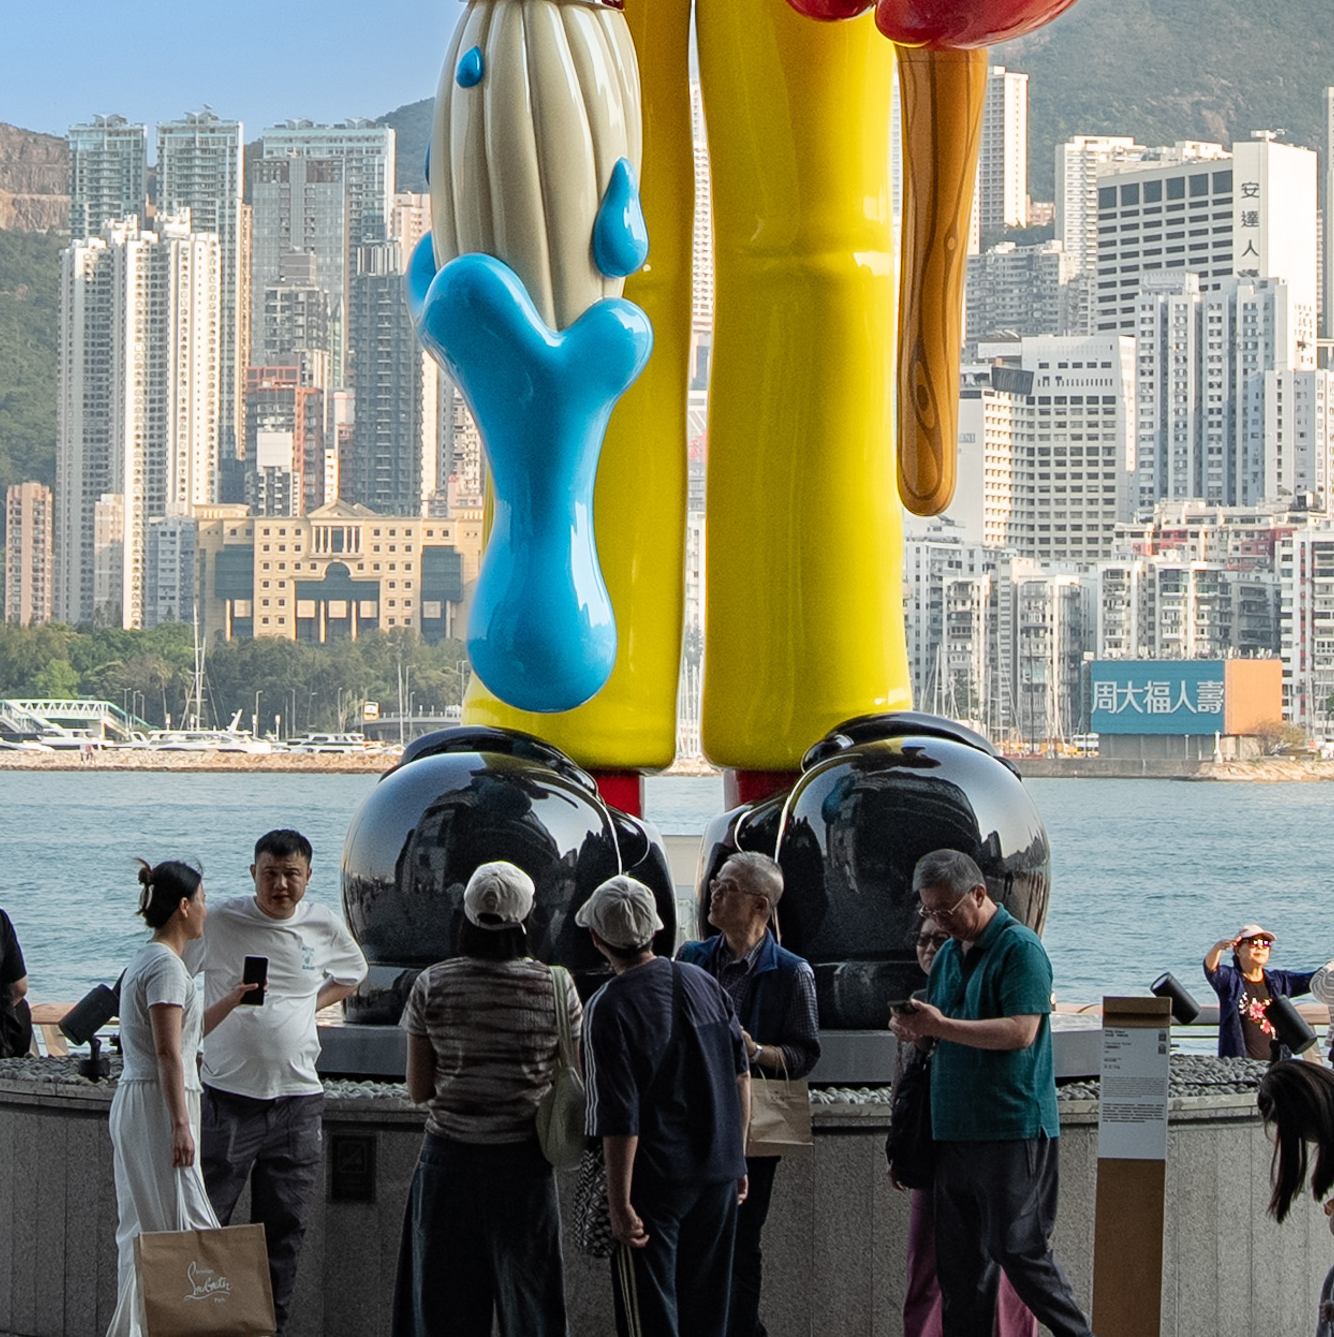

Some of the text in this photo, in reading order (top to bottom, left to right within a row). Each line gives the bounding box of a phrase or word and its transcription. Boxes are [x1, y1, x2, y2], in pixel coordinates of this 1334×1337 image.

[1091, 680, 1224, 714] 周大福人壽
